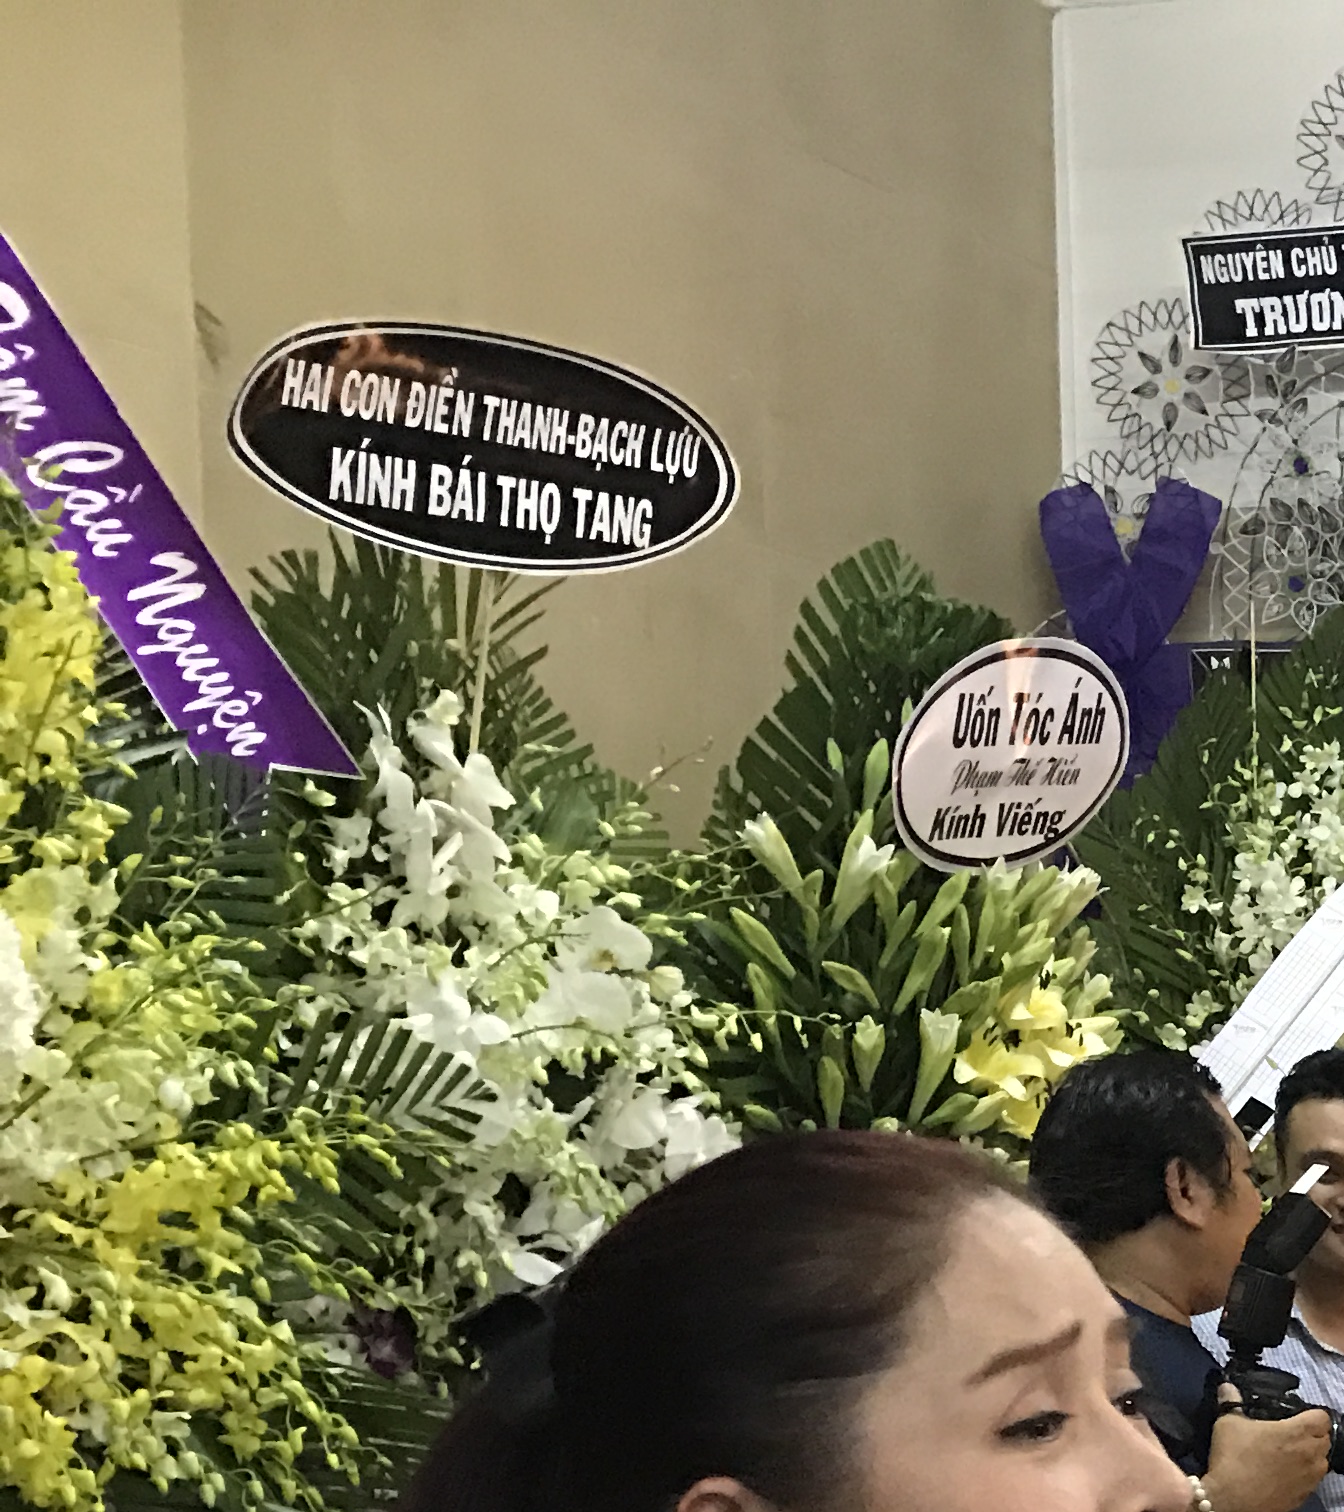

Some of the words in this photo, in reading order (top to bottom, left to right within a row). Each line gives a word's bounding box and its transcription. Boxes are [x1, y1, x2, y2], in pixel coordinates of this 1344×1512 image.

[1200, 244, 1285, 284] NGUYÊN
[1291, 237, 1338, 277] CHỦ
[282, 359, 334, 412] HAI
[340, 369, 395, 422] CON
[405, 367, 472, 438] ĐIỀN
[483, 394, 643, 471] THANH-BẠCH
[329, 436, 416, 511] KÍNH
[428, 455, 486, 522] BÁI
[497, 475, 561, 544] THỌ
[573, 490, 652, 549] TANG
[27, 441, 143, 558] Cầu
[127, 551, 268, 757] Nguyện
[953, 685, 1001, 748] Uốn
[1009, 692, 1055, 746] Tóc
[1058, 677, 1106, 745] Ánh
[951, 759, 1003, 797] Phạm
[928, 803, 987, 842] Kính
[996, 798, 1067, 841] Viếng
